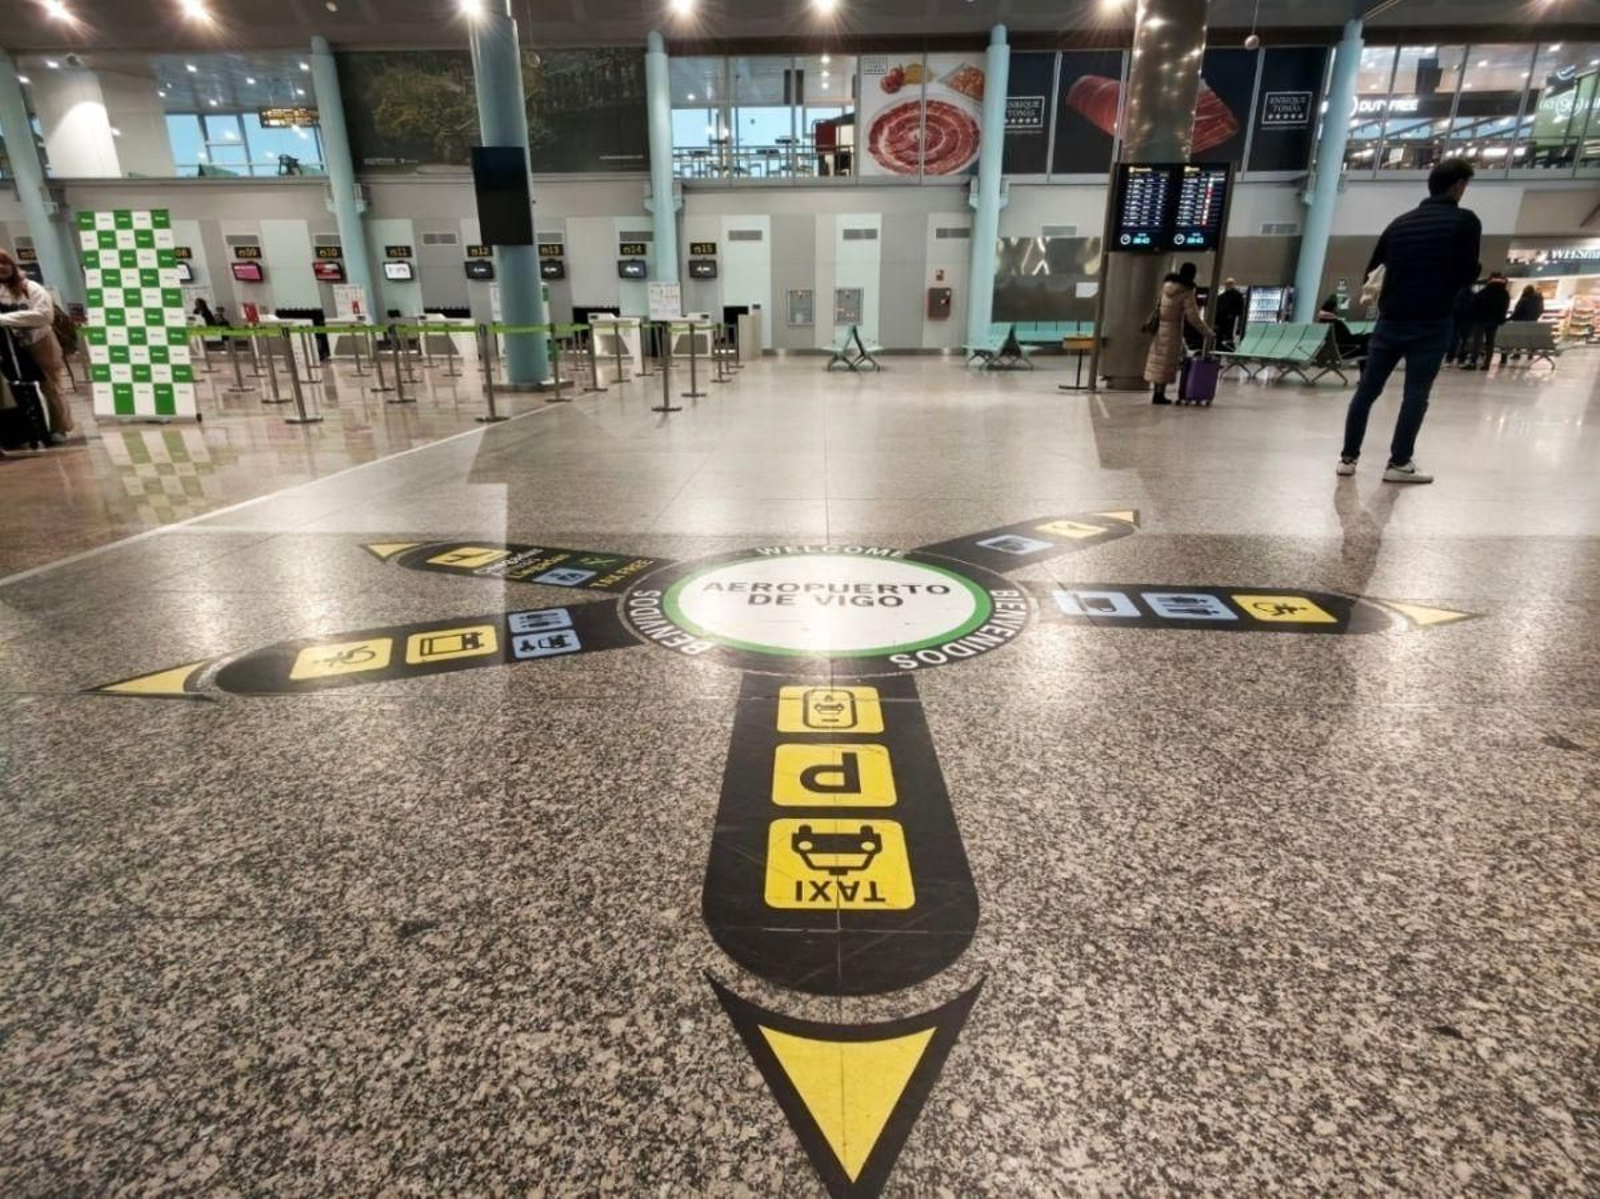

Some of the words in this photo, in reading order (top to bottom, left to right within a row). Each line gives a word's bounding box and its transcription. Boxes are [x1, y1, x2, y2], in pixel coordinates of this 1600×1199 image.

[1007, 100, 1041, 109] NRIQUE
[756, 545, 906, 557] WELCOME
[702, 581, 951, 596] AEROPUERTO
[747, 593, 797, 606] DE
[814, 594, 904, 608] VIGO
[629, 589, 714, 655] BENVIDOS
[888, 589, 1026, 669] BIENVENIDOS
[800, 752, 862, 794] P
[795, 880, 886, 902] TAXI
